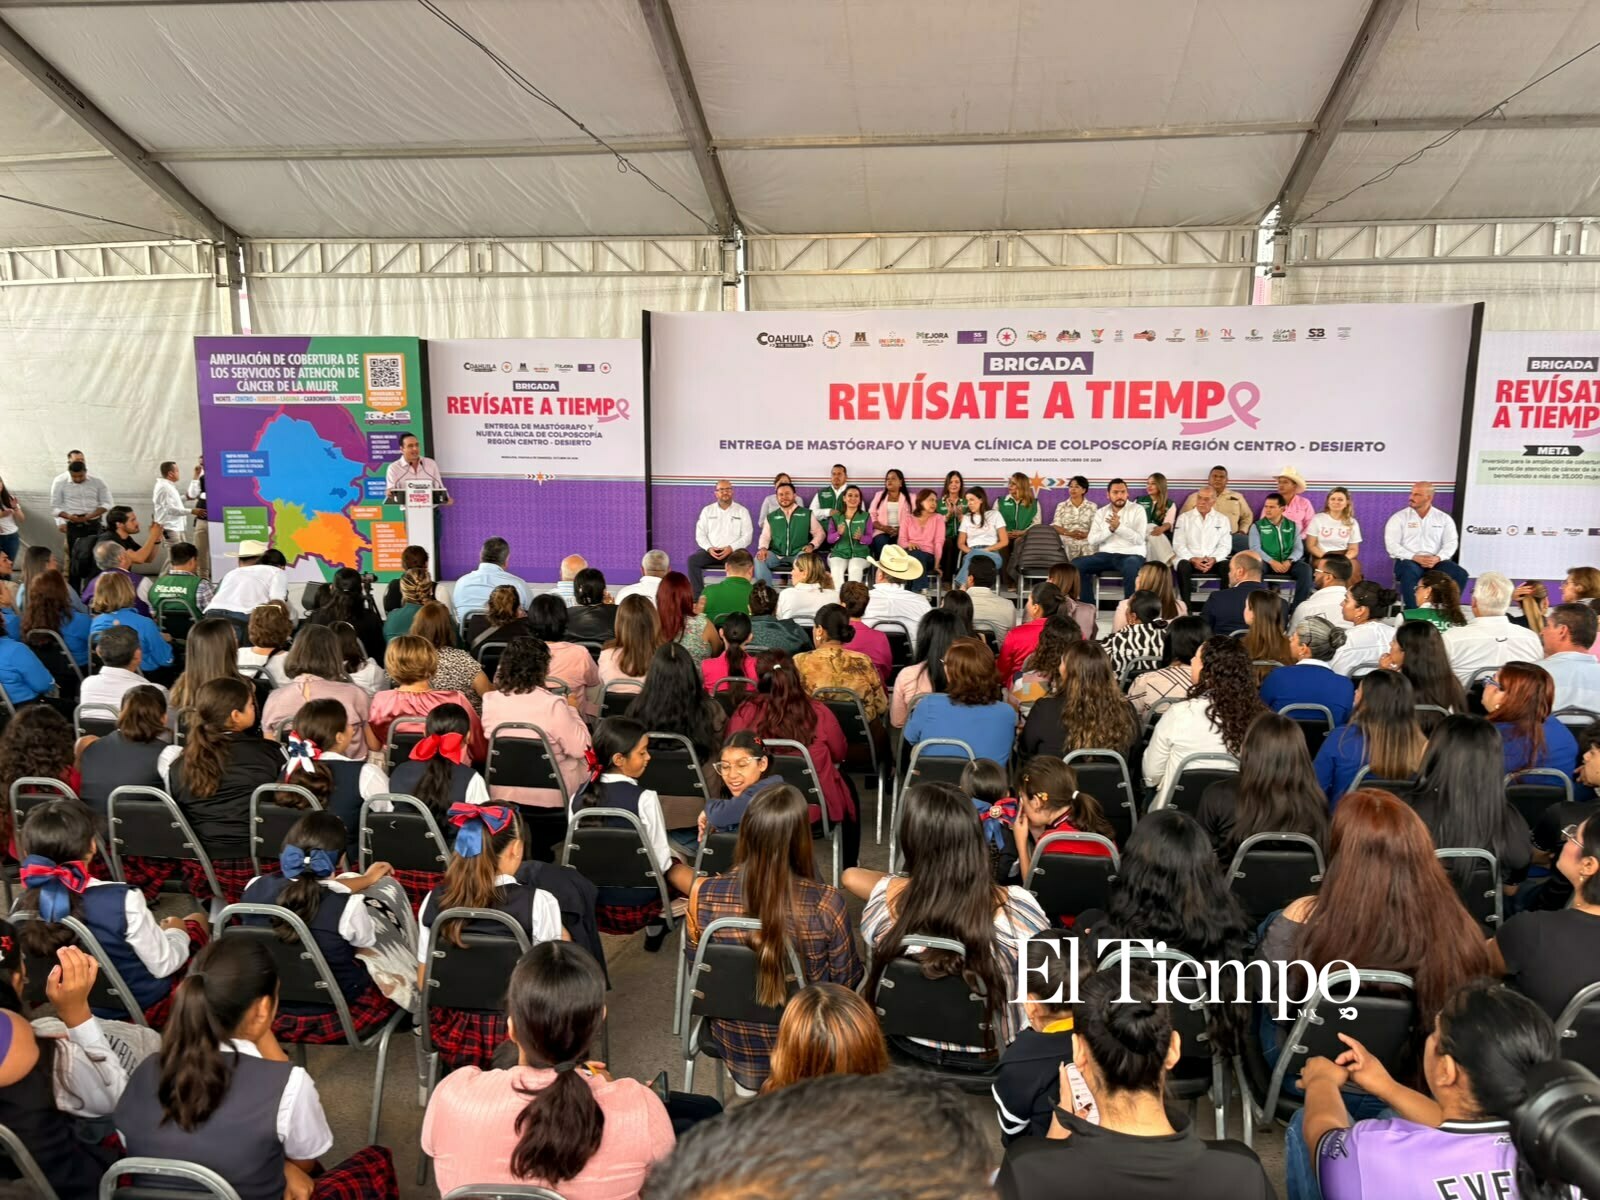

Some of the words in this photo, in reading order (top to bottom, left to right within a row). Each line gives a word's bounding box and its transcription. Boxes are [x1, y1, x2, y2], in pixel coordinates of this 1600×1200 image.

[757, 332, 813, 345] COAHUILA
[210, 352, 271, 365] AMPLIACIÓN
[273, 354, 286, 365] DE
[288, 354, 344, 365] COBERTURA
[346, 354, 359, 365] DE
[989, 356, 1086, 372] BRIGADA
[1531, 360, 1593, 370] BRIGADA
[211, 367, 229, 379] LOS
[231, 367, 281, 379] SERVICIOS
[283, 367, 296, 379] DE
[298, 365, 345, 379] ATENCIÓN
[347, 367, 360, 379] DE
[237, 379, 274, 392] CÁNCER
[277, 381, 290, 392] DE
[292, 381, 303, 392] LA
[306, 381, 338, 392] MUJER
[515, 383, 557, 391] BRIGADA
[829, 373, 1029, 420] REVÍSATE
[1043, 381, 1074, 419] A
[447, 392, 534, 415] REVÍSATE
[540, 397, 553, 415] A
[1492, 405, 1511, 428] A
[533, 422, 587, 431] MASTÓGRAFO
[504, 430, 534, 438] CLÍNICA
[548, 431, 603, 439] COLPOSCOPÍA
[719, 440, 782, 450] ENTREGA
[786, 440, 803, 450] DE
[807, 437, 904, 451] MASTÓGRAFO
[908, 440, 917, 450] Y
[921, 440, 971, 450] NUEVA
[975, 437, 1033, 450] CLÍNICA
[1037, 440, 1056, 450] DE
[1060, 437, 1167, 451] COLPOSCOPÍA
[1172, 438, 1229, 451] REGIÓN
[1234, 441, 1296, 452] CENTRO
[1309, 441, 1385, 452] DESIERTO
[1537, 447, 1570, 455] META
